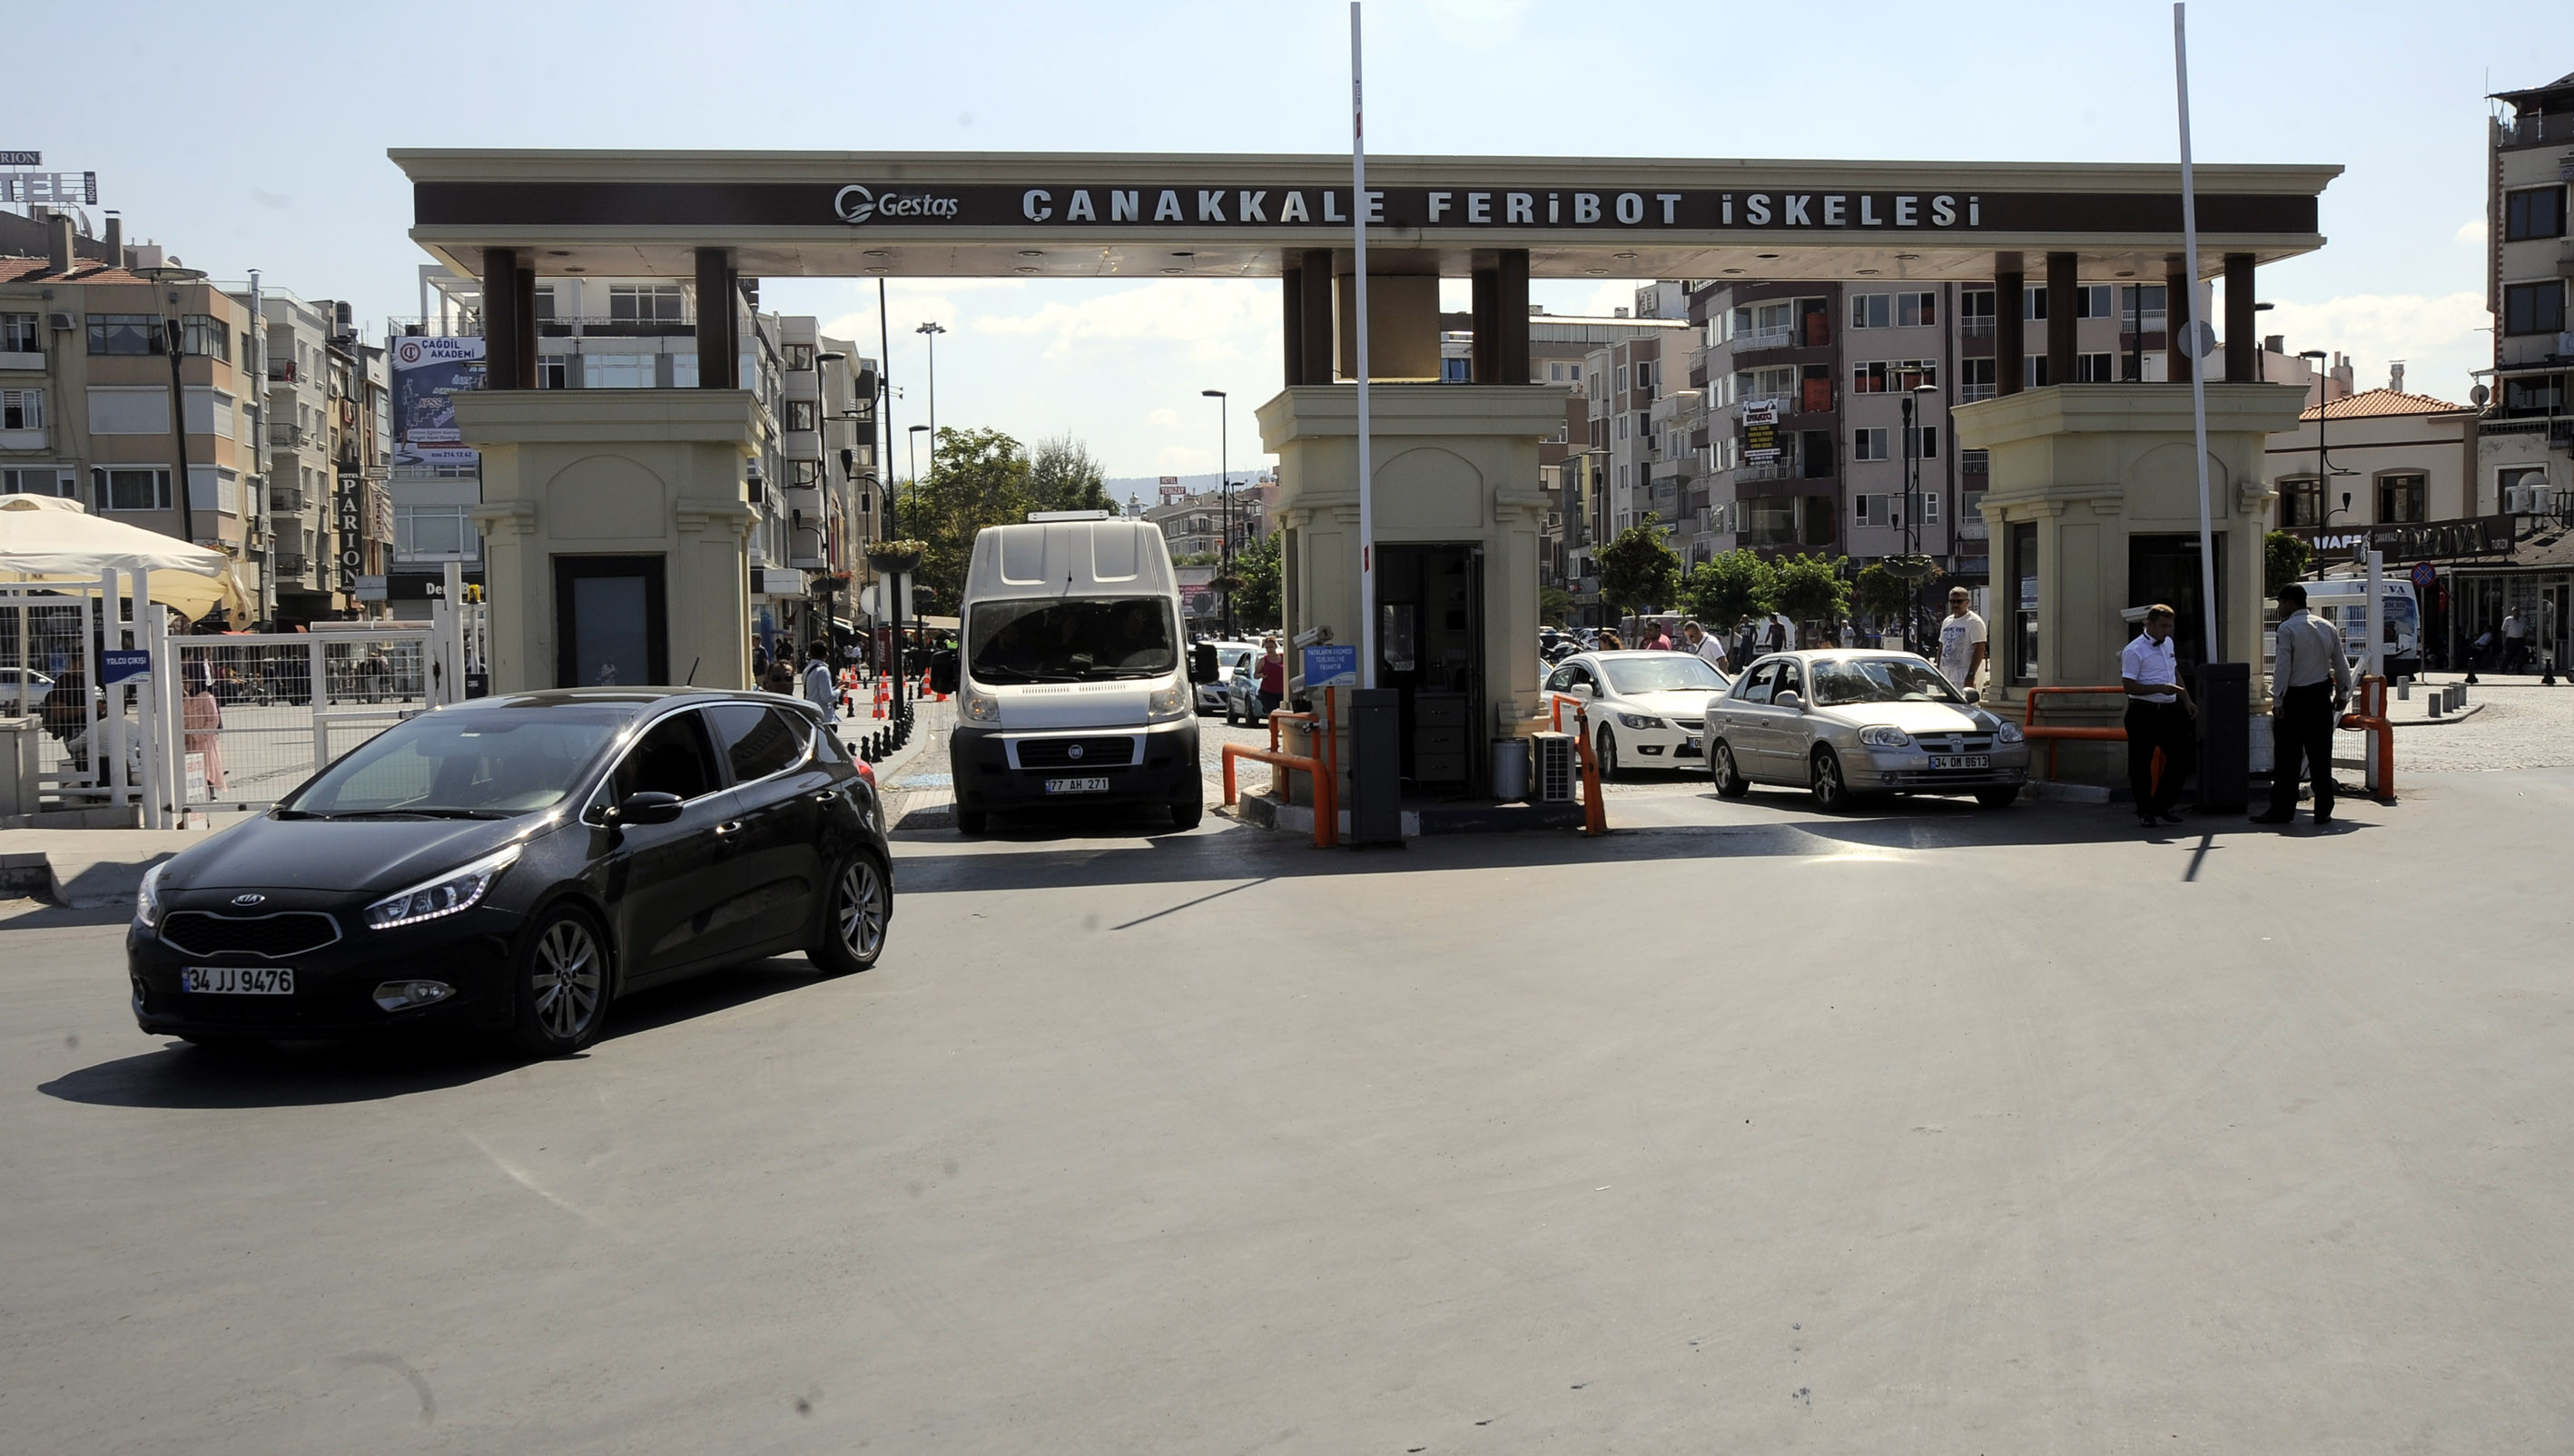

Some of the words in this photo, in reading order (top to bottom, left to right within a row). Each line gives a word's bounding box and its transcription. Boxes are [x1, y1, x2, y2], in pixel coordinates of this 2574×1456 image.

[86, 175, 95, 202] HOUSE
[878, 192, 959, 220] Gestaş
[1022, 189, 1386, 223] ÇANAKKALE
[421, 339, 460, 349] ÇAĞDİL
[430, 349, 475, 359] AKADEMİ
[341, 479, 361, 584] PARION
[105, 657, 127, 666] YOLCU
[127, 656, 147, 666] ÇIKIŞI
[1935, 757, 1948, 768] 34
[1051, 781, 1064, 791] 77
[1070, 780, 1083, 790] AH
[1088, 778, 1107, 790] 271
[236, 894, 258, 902] KIA
[190, 969, 211, 991] 34
[215, 969, 236, 992] JJ
[241, 969, 291, 993] 9476
